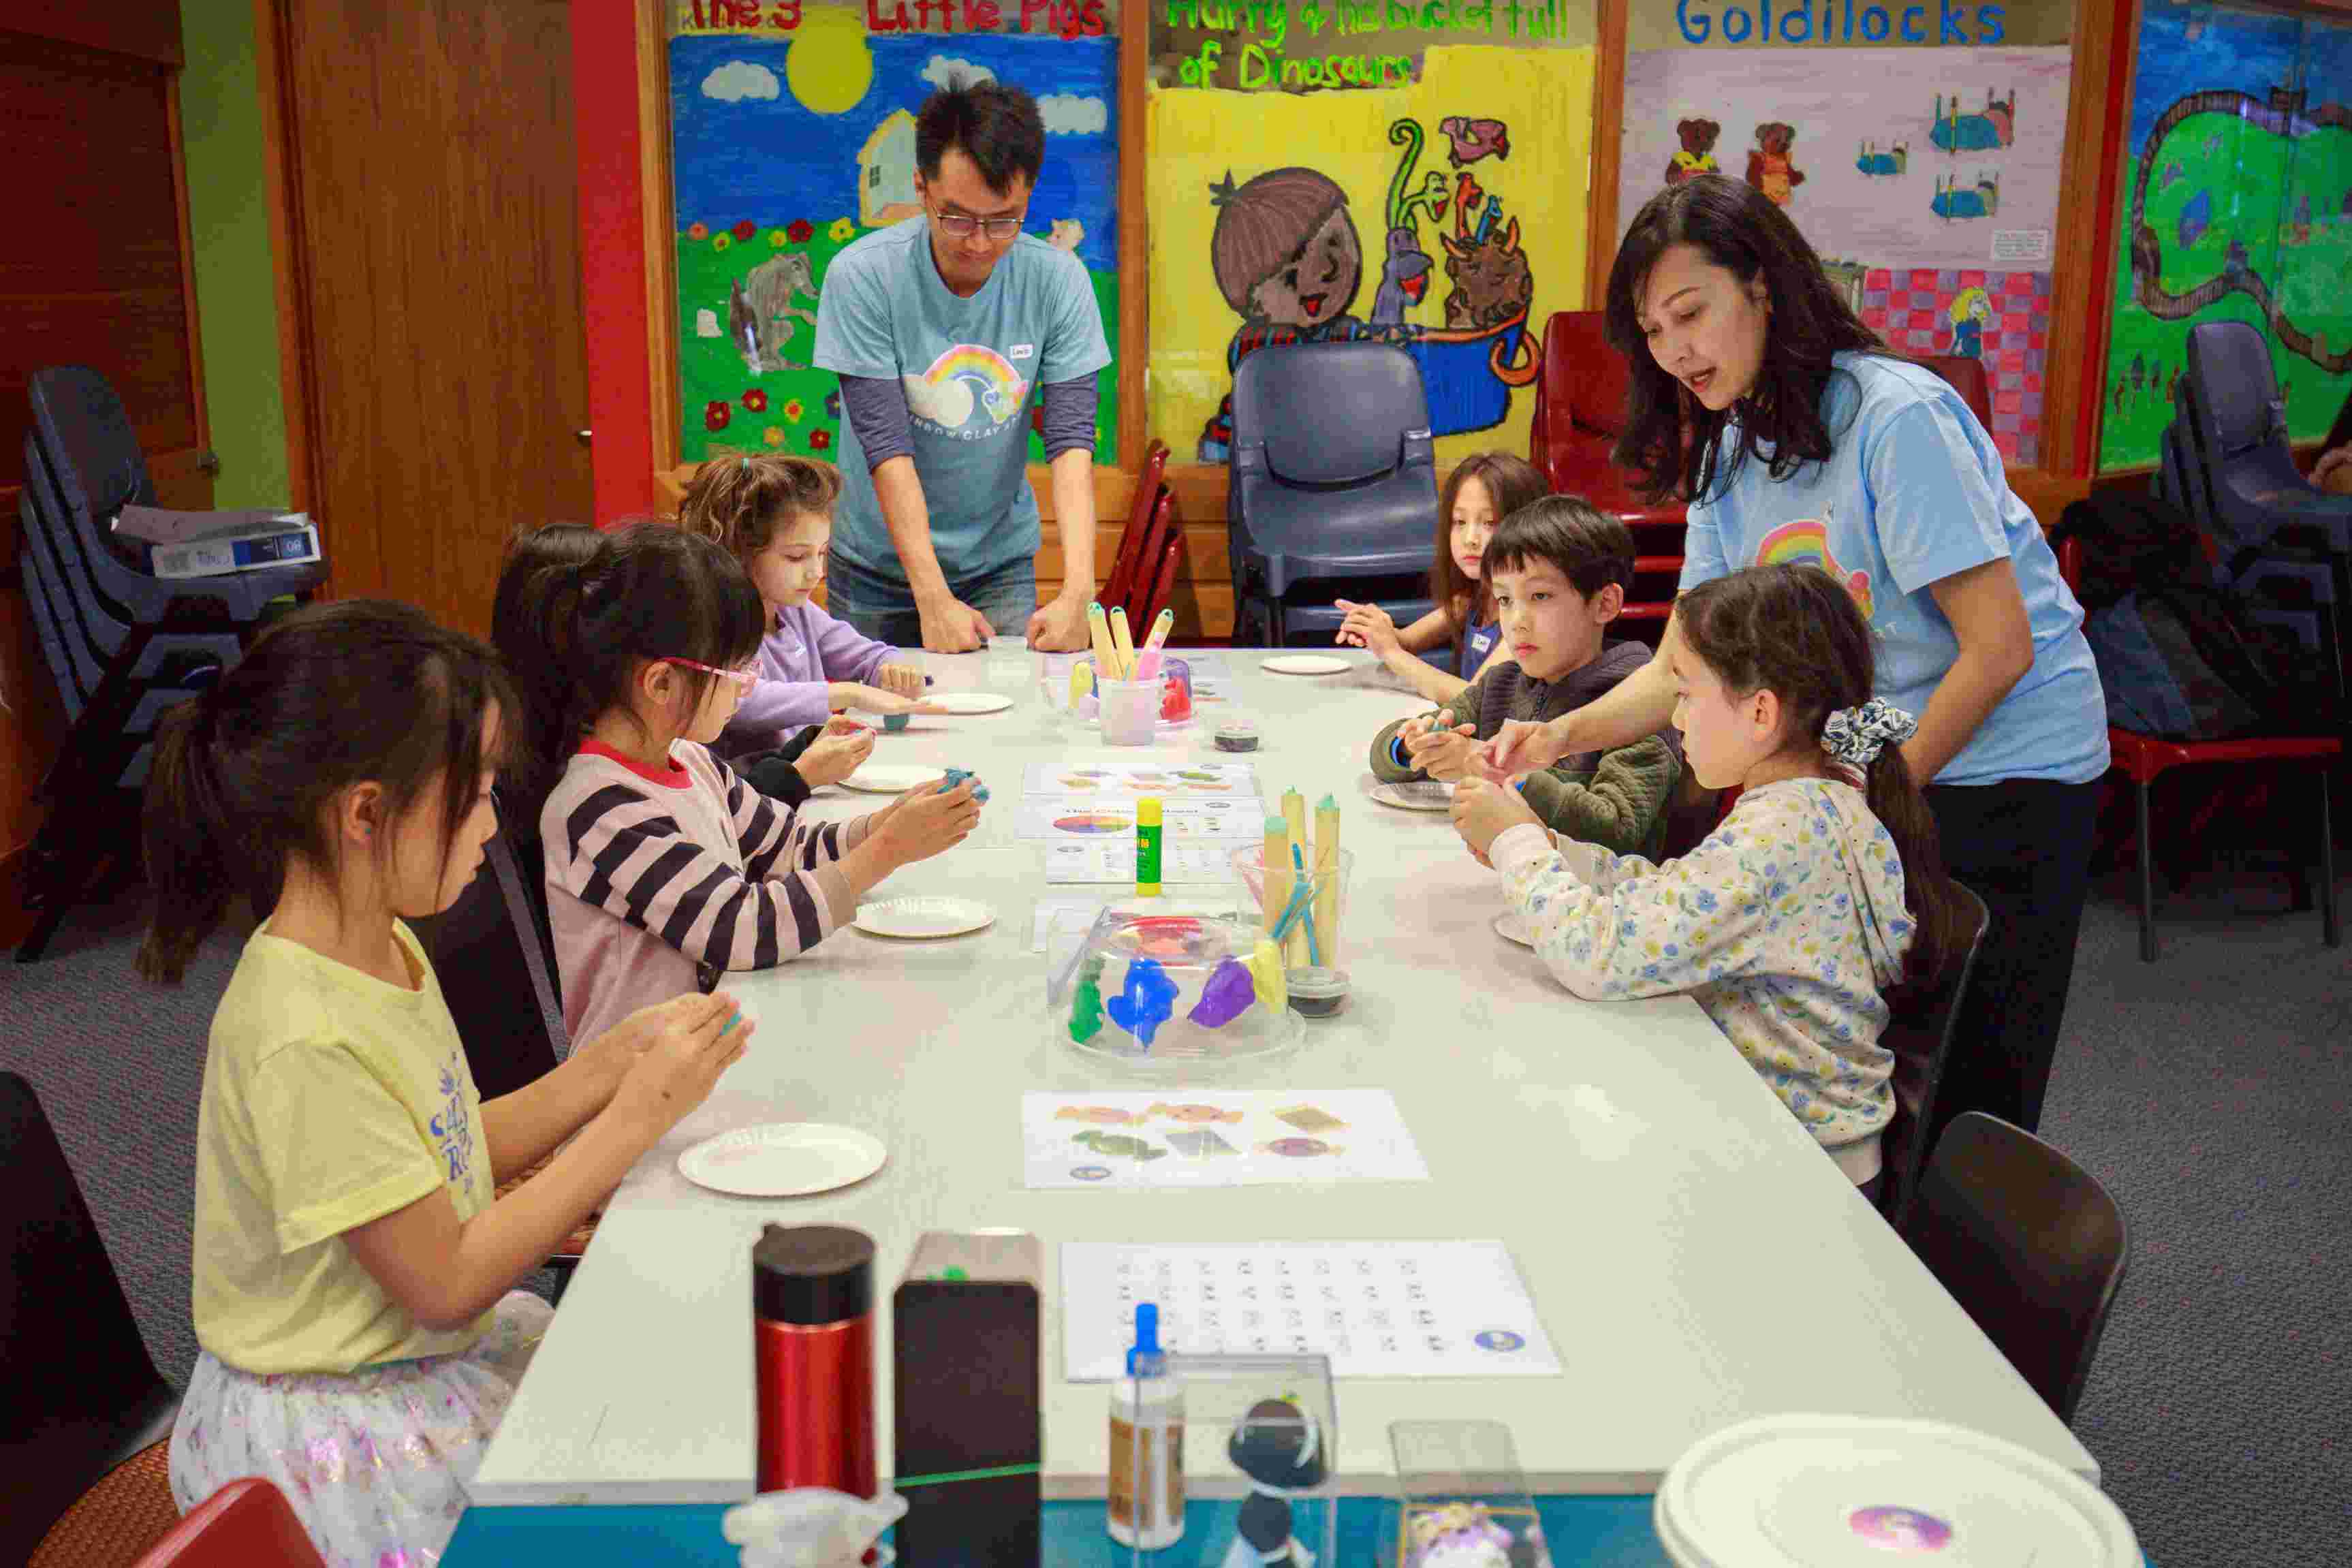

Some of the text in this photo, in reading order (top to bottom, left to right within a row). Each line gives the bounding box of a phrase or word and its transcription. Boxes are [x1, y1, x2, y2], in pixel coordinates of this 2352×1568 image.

[774, 0, 802, 30] 3
[868, 0, 1001, 31] Little
[1021, 0, 1105, 41] Pigs
[1676, 0, 2006, 44] Goldilocks
[1180, 39, 1413, 90] of Dinosaurs
[962, 427, 999, 441] CLAY
